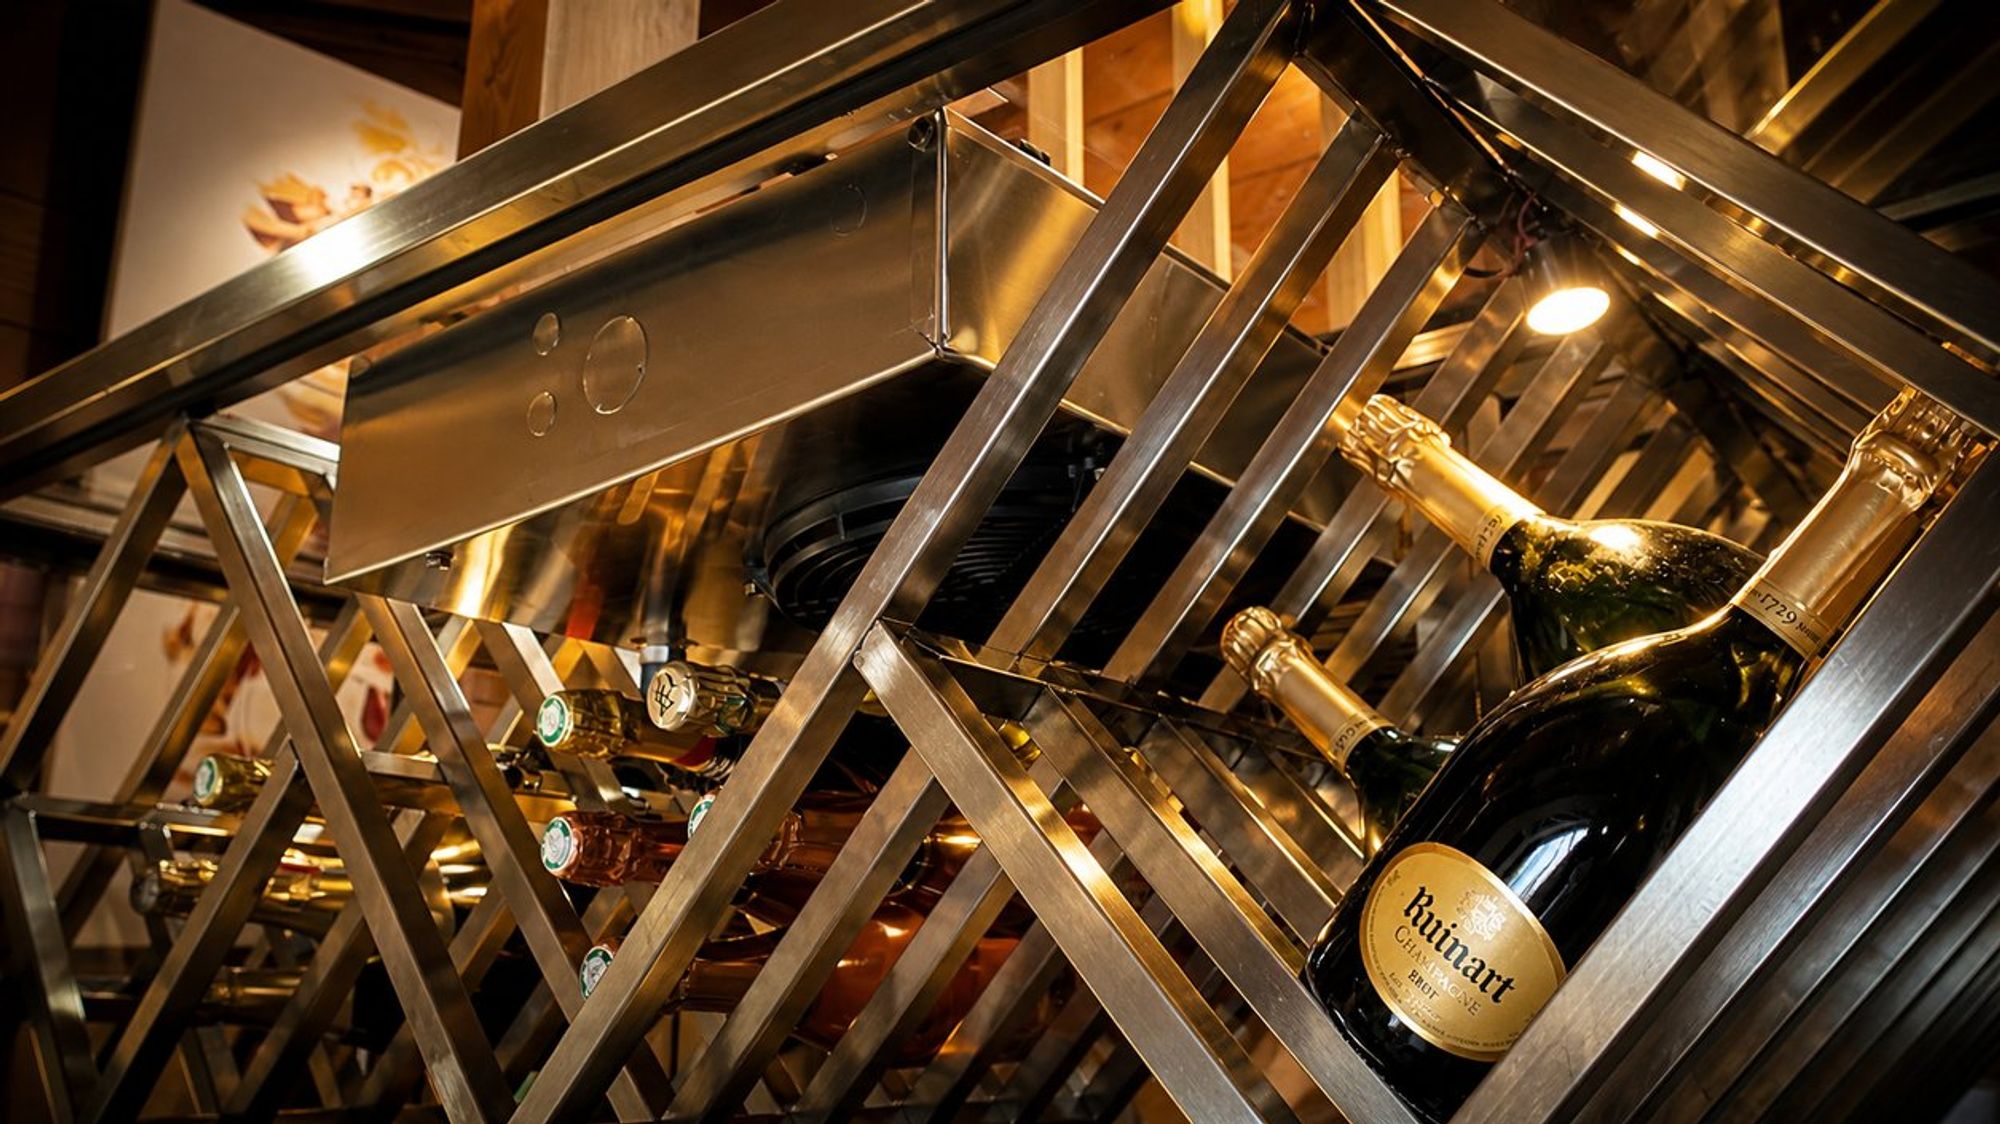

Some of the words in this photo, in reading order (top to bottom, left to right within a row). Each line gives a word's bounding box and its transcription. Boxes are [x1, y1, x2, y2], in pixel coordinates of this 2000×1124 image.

[1759, 593, 1798, 625] 1729
[1394, 924, 1482, 1017] CHAMPAGNE
[1403, 886, 1516, 1004] Ruinart
[1408, 969, 1440, 1000] BRUT
